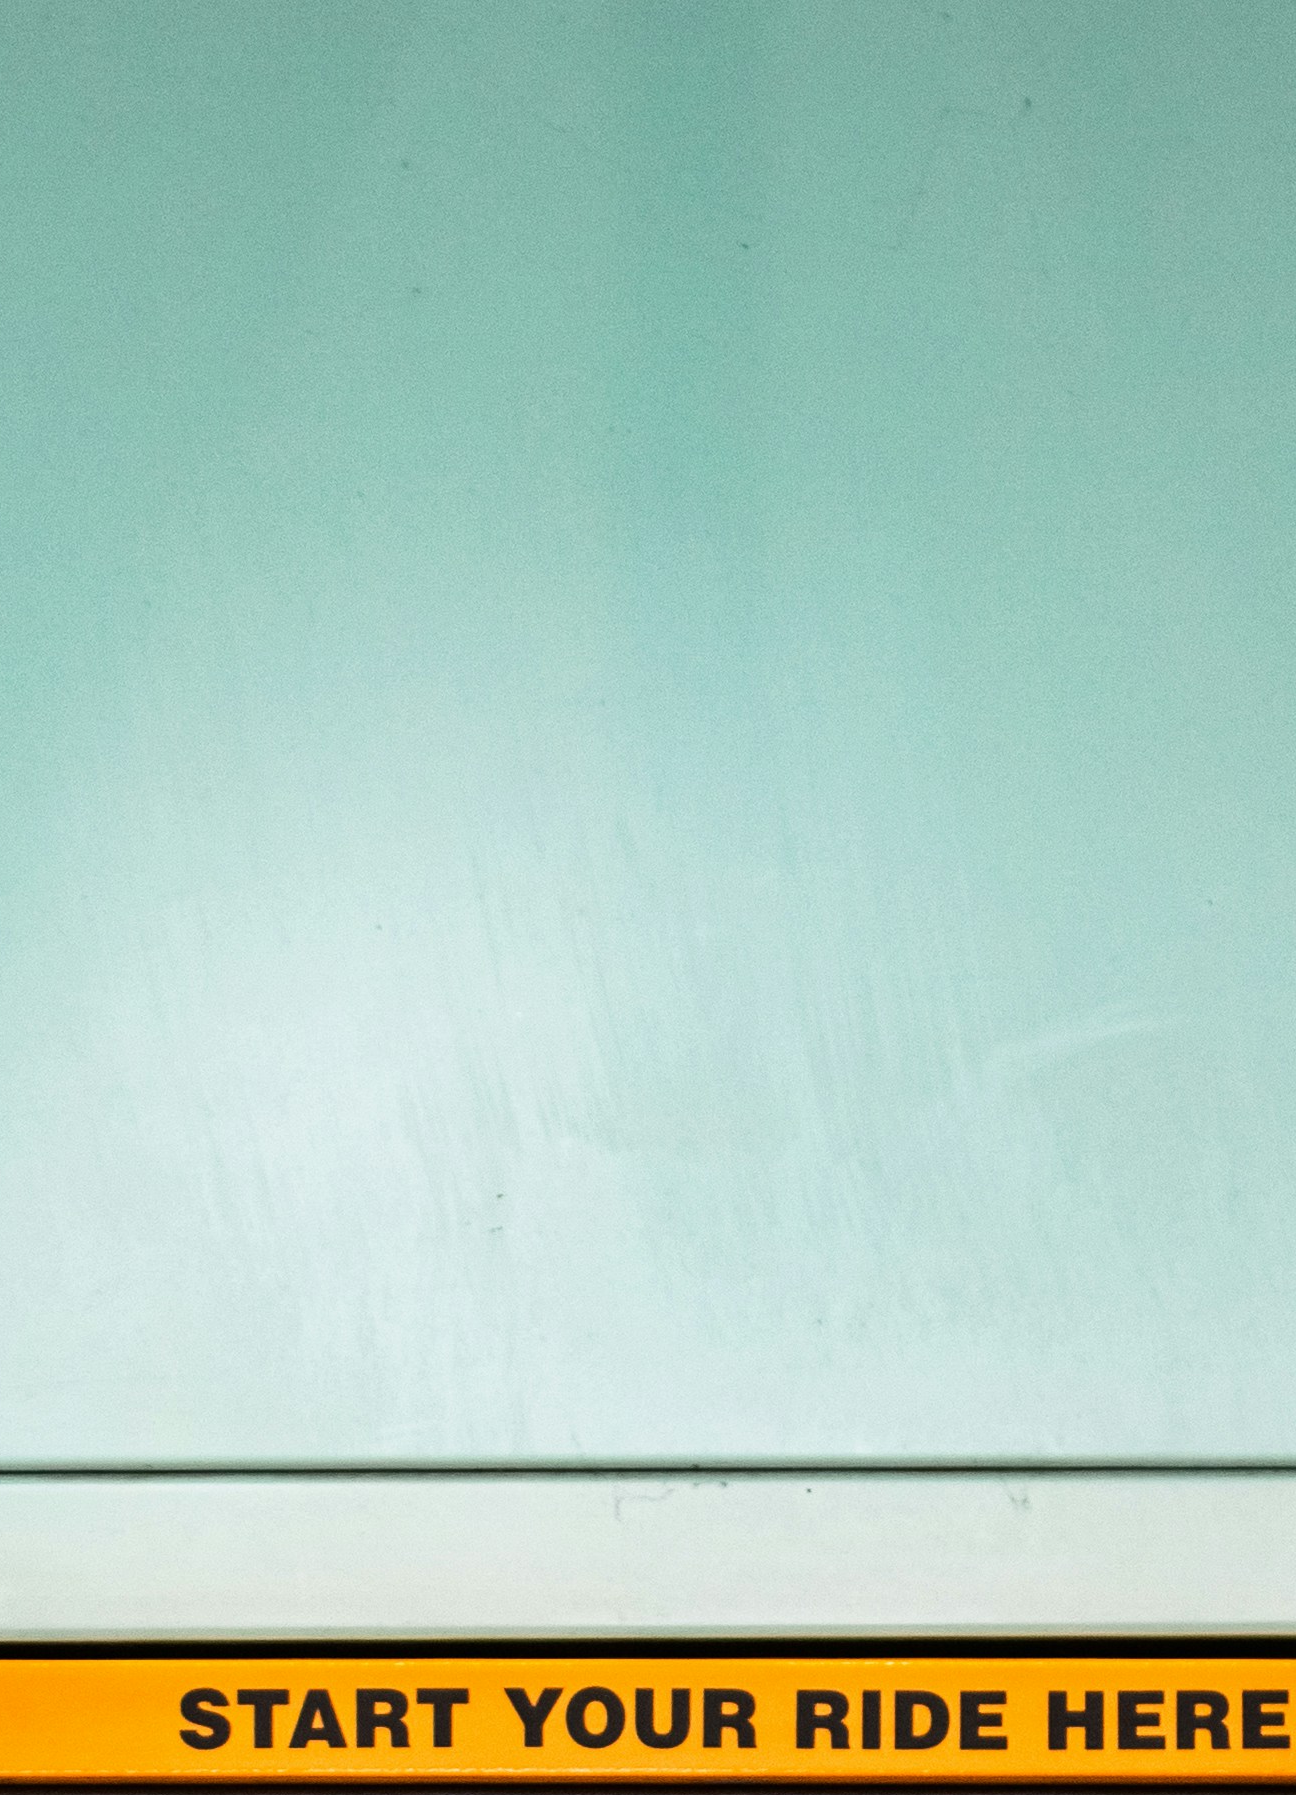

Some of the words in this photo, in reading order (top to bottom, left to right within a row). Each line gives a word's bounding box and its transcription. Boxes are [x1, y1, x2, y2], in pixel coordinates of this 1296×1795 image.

[180, 1688, 469, 1750] START
[504, 1687, 756, 1749] YOUR
[796, 1690, 1008, 1750] RIDE
[1048, 1690, 1290, 1750] HERE
